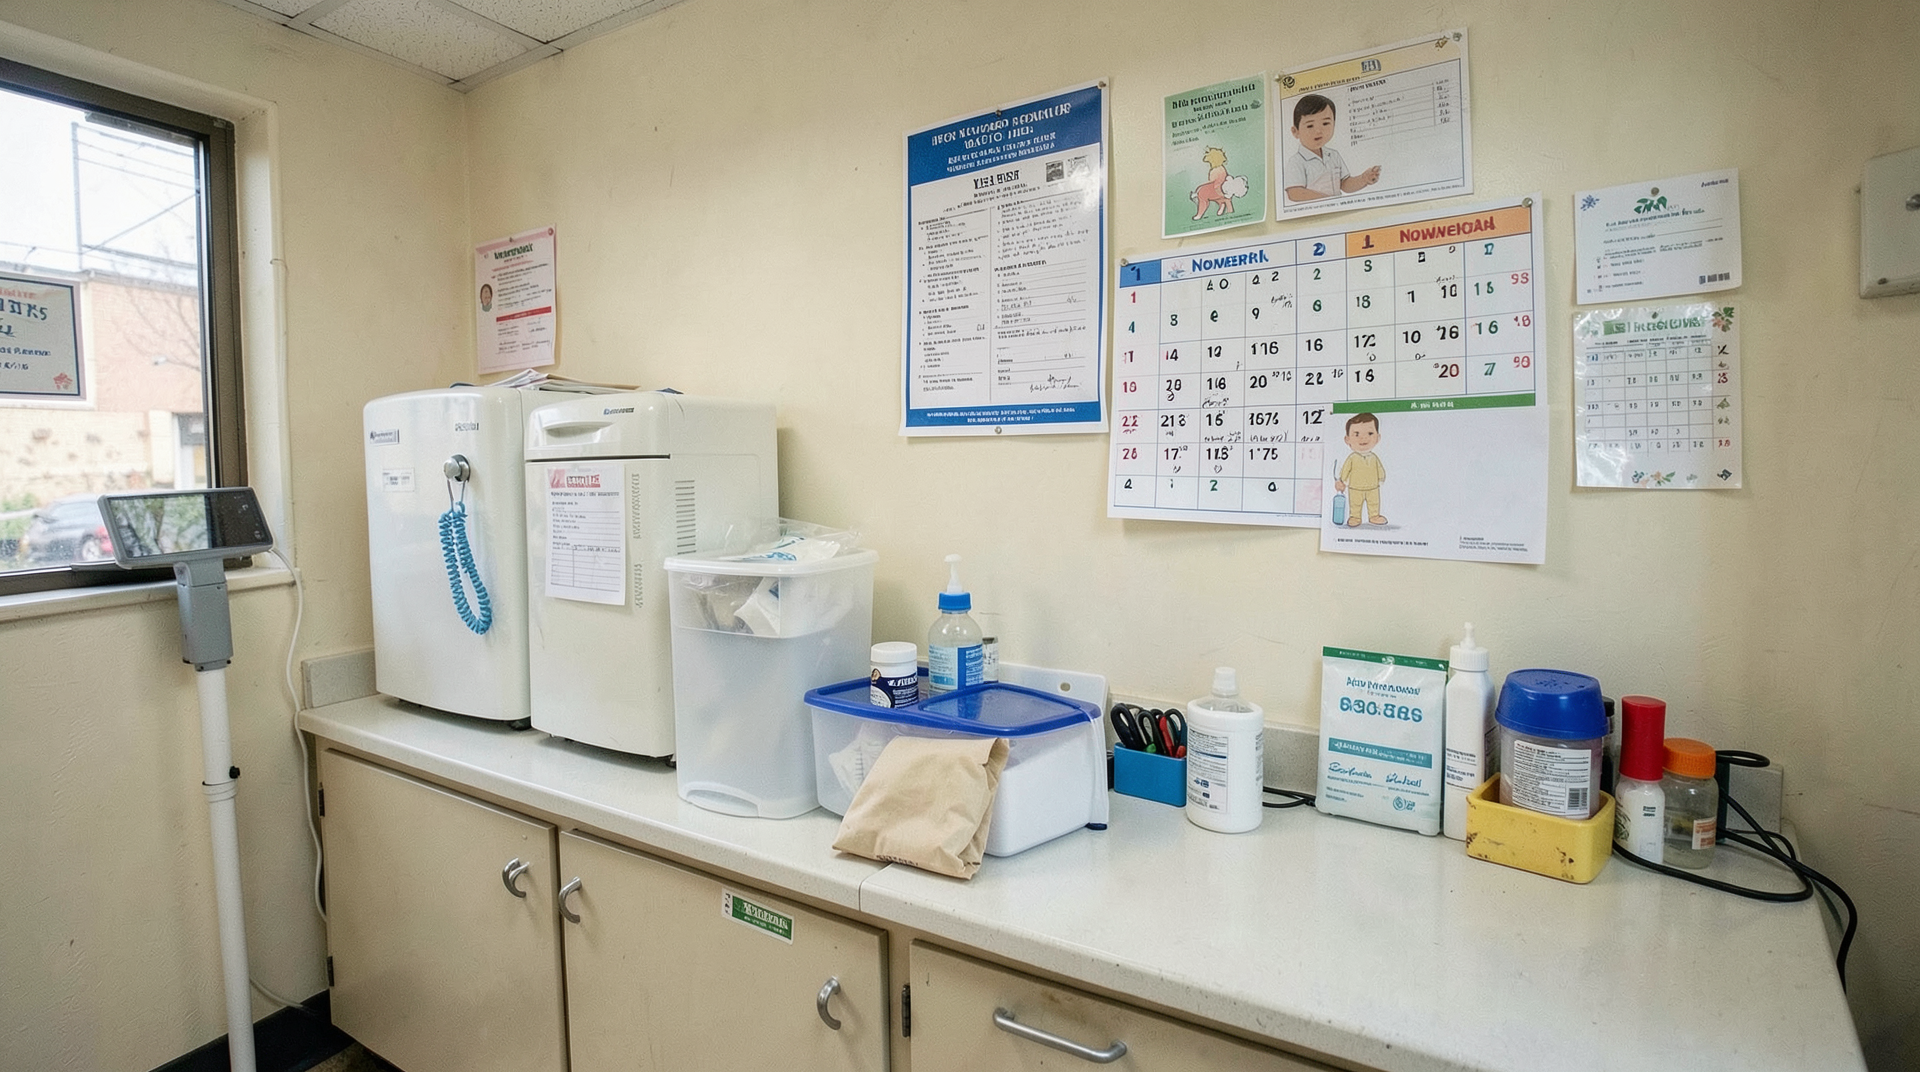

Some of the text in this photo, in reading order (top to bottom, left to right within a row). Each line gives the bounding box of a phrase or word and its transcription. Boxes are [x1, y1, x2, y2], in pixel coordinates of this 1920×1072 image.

[1313, 268, 1321, 280] 2
[1306, 338, 1323, 352] 16
[1403, 331, 1421, 343] 10
[1250, 375, 1267, 388] 20
